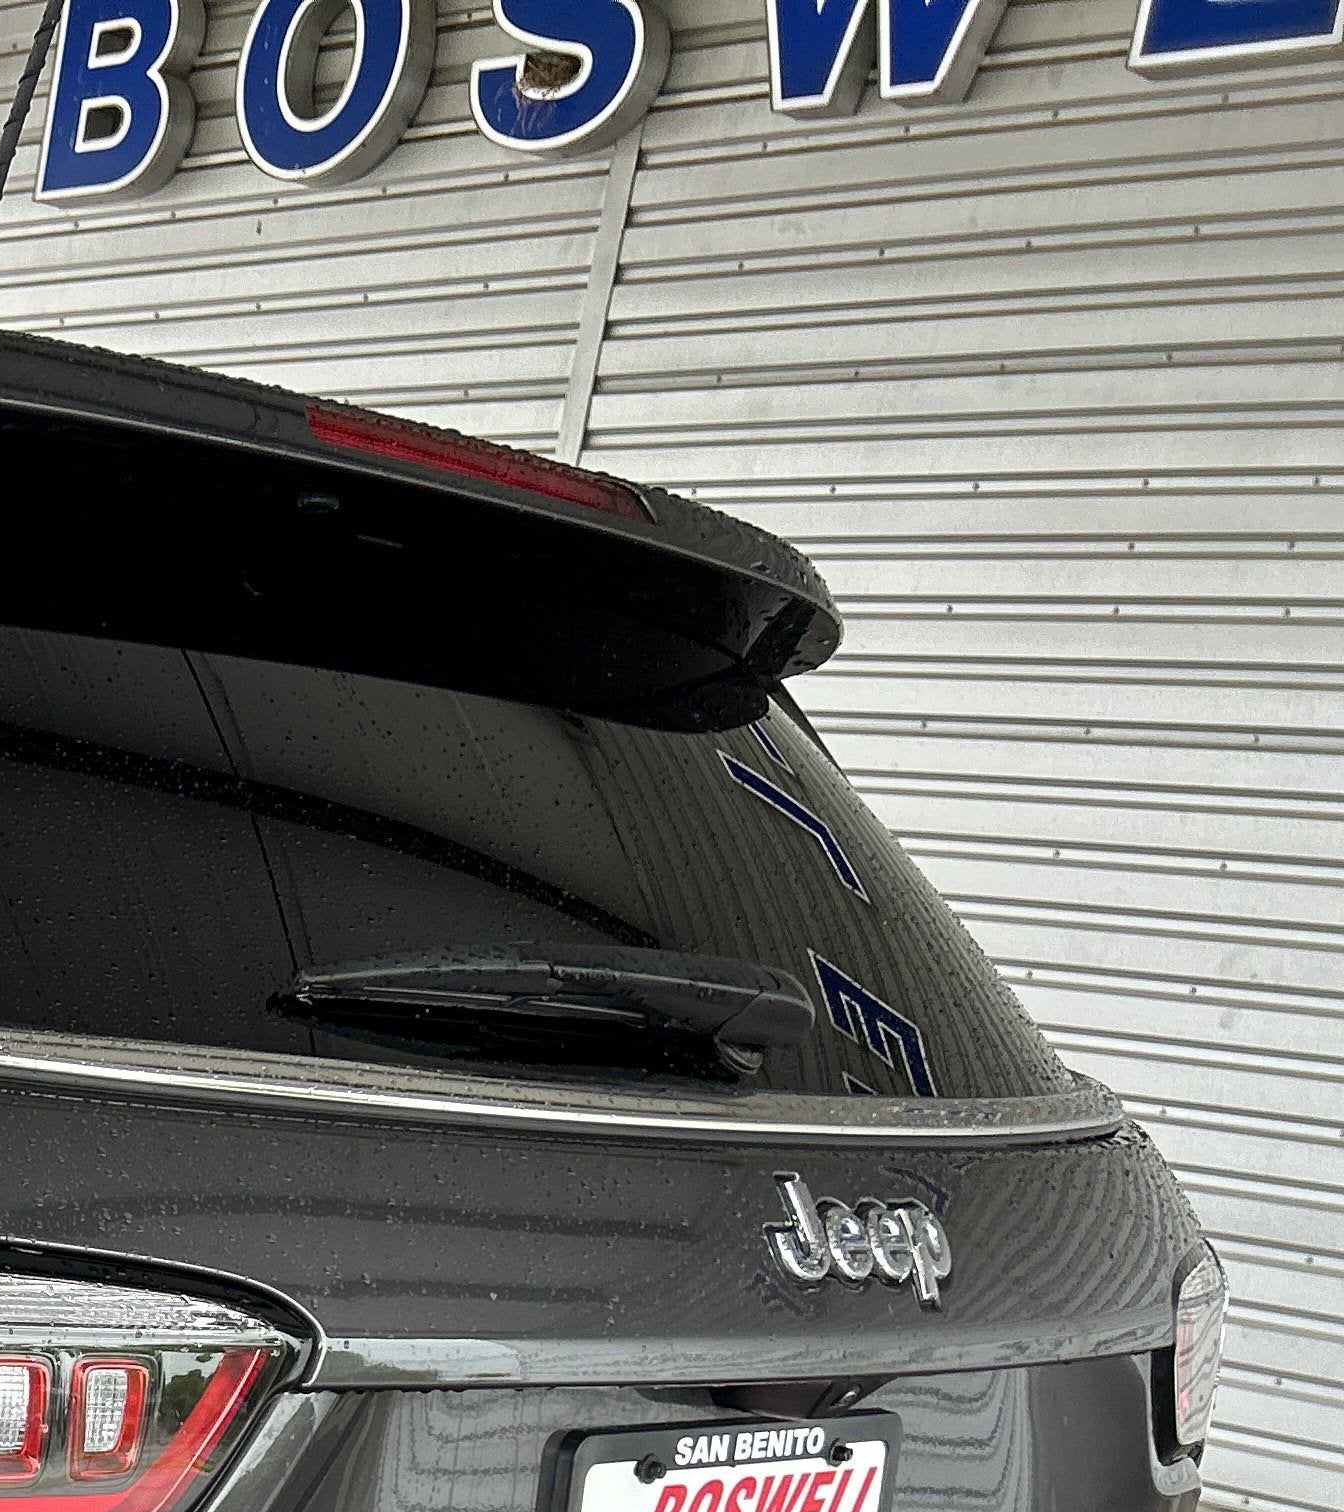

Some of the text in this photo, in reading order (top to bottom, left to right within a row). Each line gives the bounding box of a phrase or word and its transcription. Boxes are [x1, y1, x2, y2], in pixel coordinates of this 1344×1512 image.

[763, 1171, 953, 1312] Jeep
[674, 1427, 825, 1466] SAN BENITO
